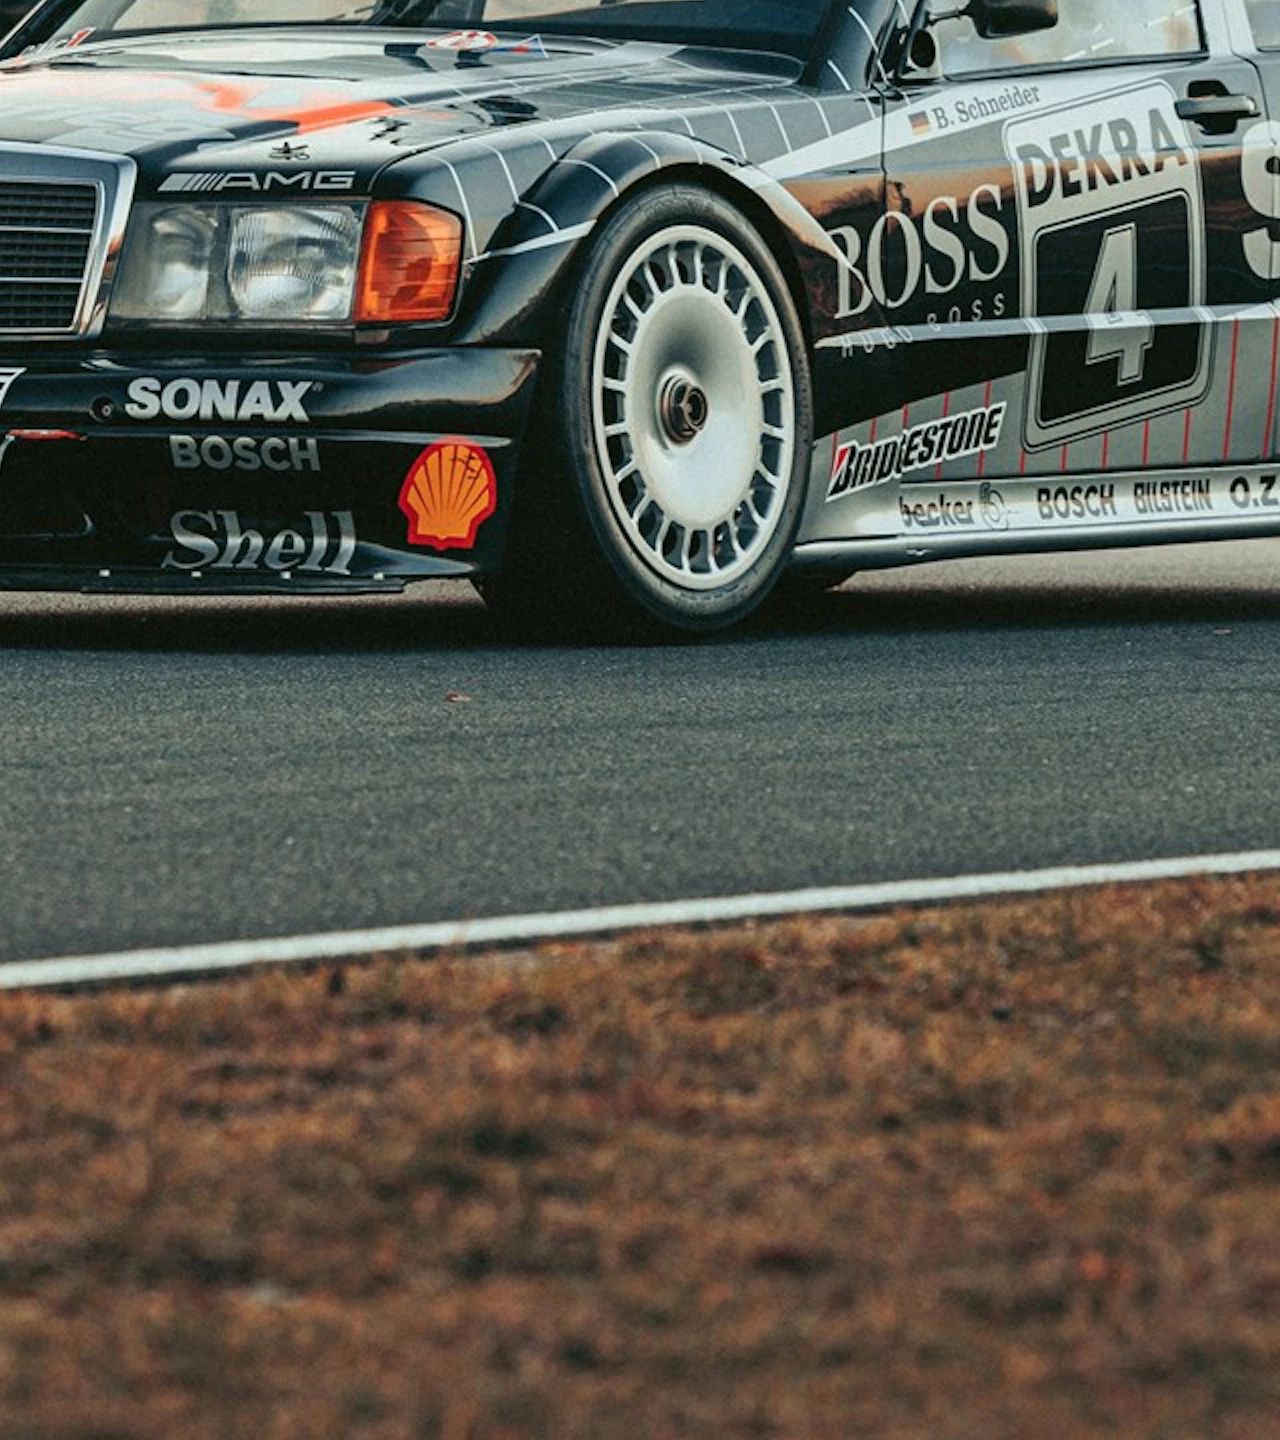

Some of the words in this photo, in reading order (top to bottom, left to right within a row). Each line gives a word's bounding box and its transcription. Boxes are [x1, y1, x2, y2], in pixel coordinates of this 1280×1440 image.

[932, 107, 956, 130] B.
[957, 84, 1041, 123] Schneider
[1016, 107, 1187, 208] DEKRA
[215, 171, 356, 191] AMG
[827, 183, 1010, 320] BOSS
[926, 292, 1006, 332] BOSS
[1084, 221, 1156, 387] 4
[169, 435, 320, 471] BOSCH
[899, 493, 975, 526] becker
[1038, 483, 1118, 519] BOSCH
[1134, 478, 1213, 514] BILSTEIN
[163, 510, 356, 575] Shell
